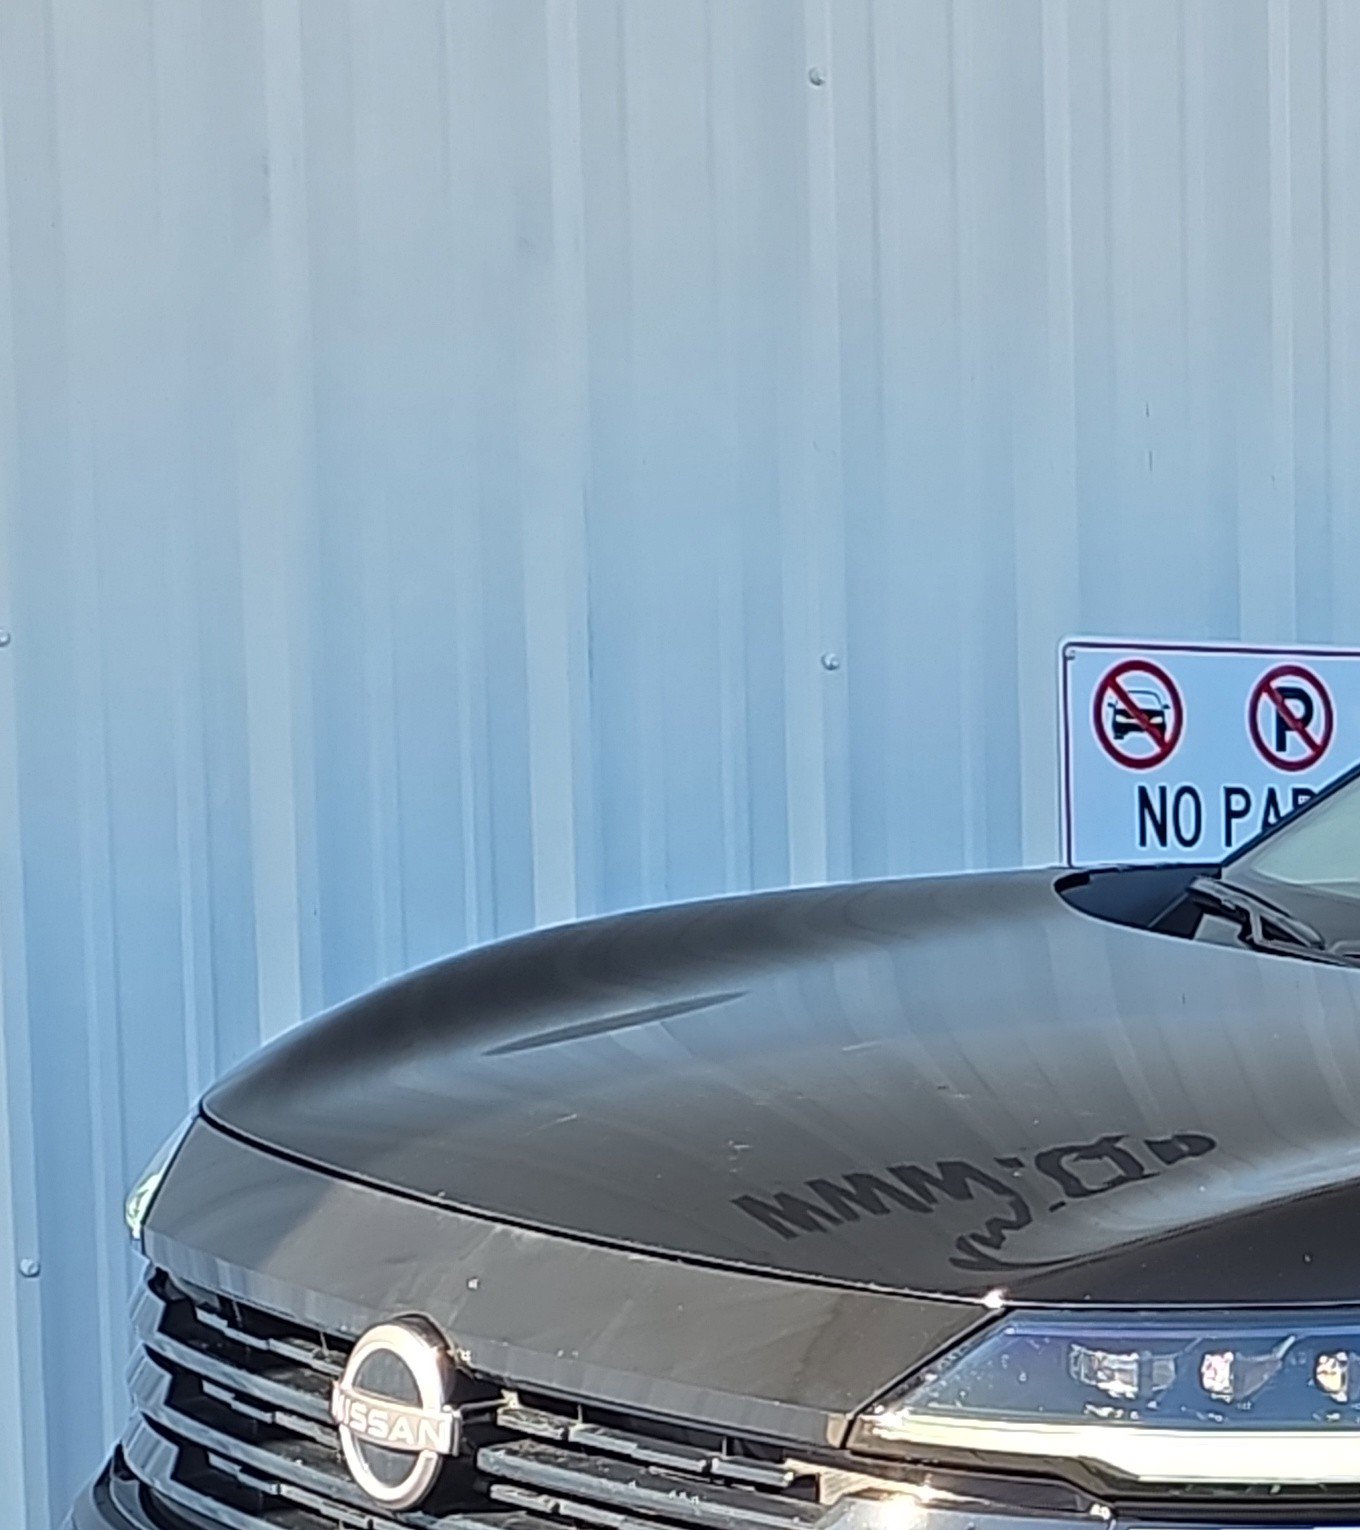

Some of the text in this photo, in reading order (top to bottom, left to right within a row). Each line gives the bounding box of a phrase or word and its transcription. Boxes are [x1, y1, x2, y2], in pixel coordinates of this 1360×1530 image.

[1138, 785, 1320, 848] NO PA
[333, 1389, 453, 1454] NISSAN
